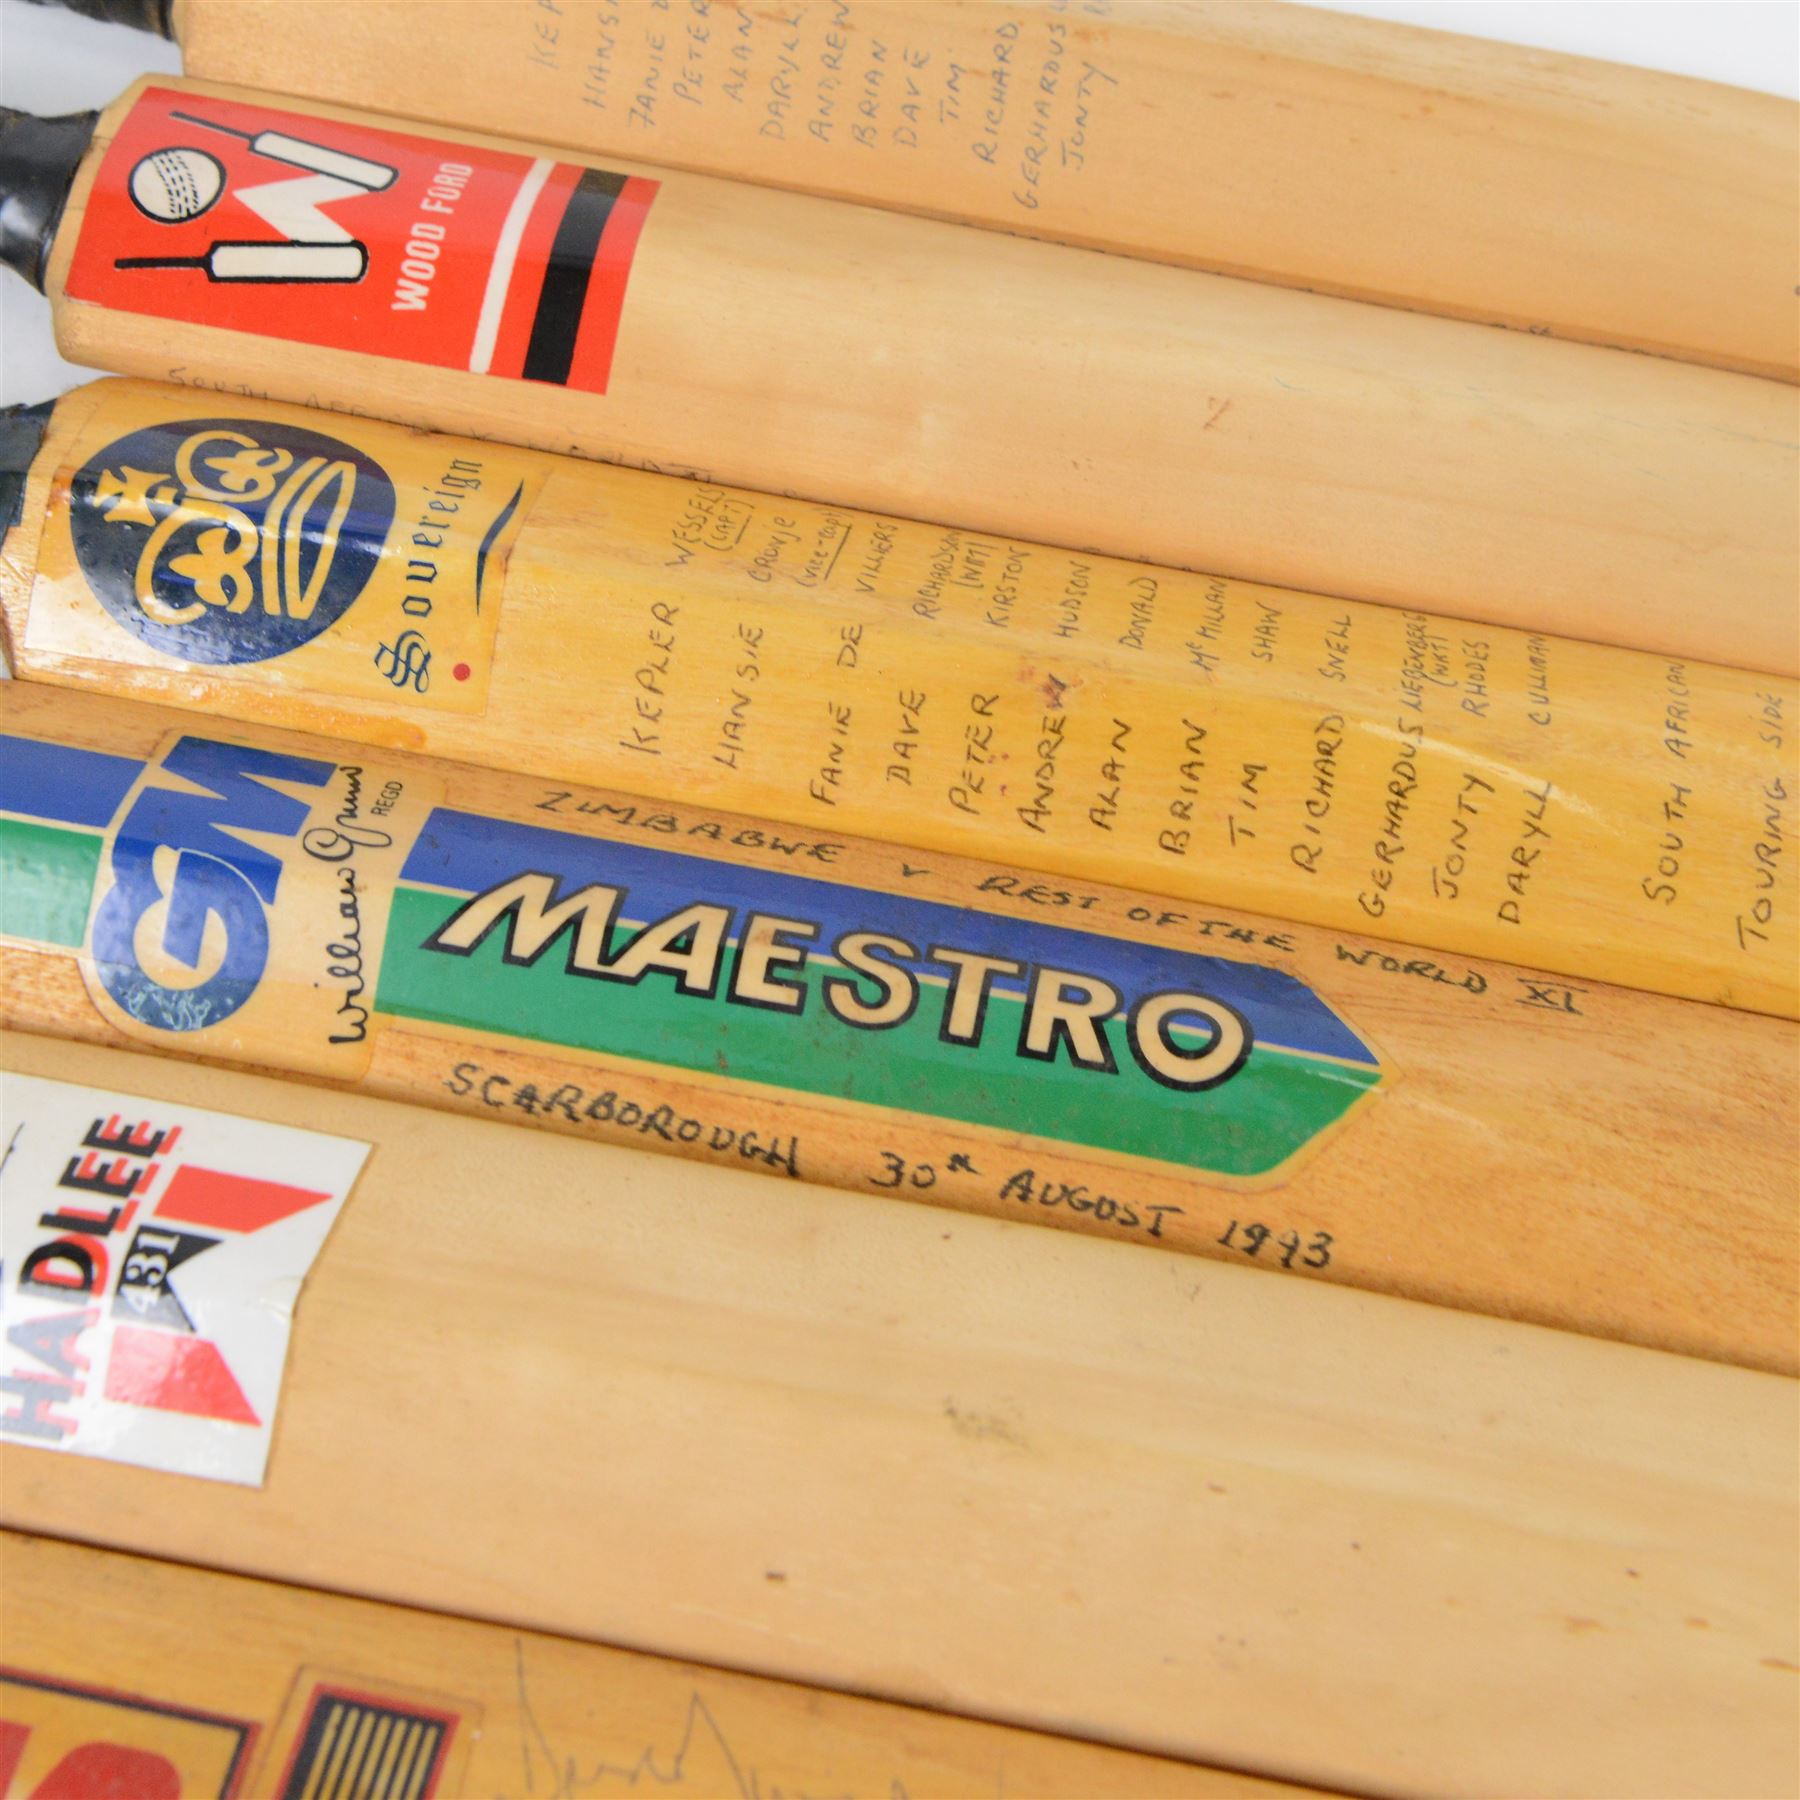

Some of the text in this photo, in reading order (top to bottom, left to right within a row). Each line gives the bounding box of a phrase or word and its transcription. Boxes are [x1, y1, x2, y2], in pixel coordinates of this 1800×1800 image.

[722, 8, 754, 103] ALAN
[852, 38, 888, 149] BRIAN
[893, 47, 931, 149] DAVE
[938, 62, 968, 124] TIM
[971, 22, 1020, 165] RICHARD
[1012, 23, 1067, 210] GERHARDUS
[1060, 60, 1120, 172] JONTY
[390, 162, 474, 312] WOOD FORD
[374, 457, 484, 695] Sovereign
[619, 601, 680, 756] KEPLER
[712, 622, 764, 770] HANSIE
[809, 701, 851, 806] FANIE
[836, 623, 863, 669] DE
[885, 689, 927, 787] DAVE
[949, 692, 1001, 816] PETER
[1017, 559, 1094, 834] ANDREW HUDSON
[1088, 575, 1160, 832] ALAN DONALD
[1227, 600, 1283, 848] TIM SHAW
[1290, 615, 1353, 875] RICHARD SNELL
[370, 780, 404, 818] REGD
[1158, 717, 1208, 856] BRIAN
[1358, 716, 1425, 919] GERHARDUS
[1432, 638, 1497, 901] JONTY RHODES
[1497, 781, 1554, 926] DARYLL
[1641, 659, 1694, 907] SOUTH AFRICAN
[1736, 691, 1789, 952] TOURING SIDE
[91, 735, 339, 1032] GM
[534, 789, 846, 864] ZIMBABWE
[975, 874, 1102, 910] REST
[1126, 906, 1190, 928] OF
[1197, 919, 1298, 953] THE
[1334, 942, 1490, 996] WORLD
[1514, 975, 1591, 1016] XI
[419, 869, 1255, 1094] MAESTRO
[441, 1061, 802, 1178] SCARBOROUGH
[999, 1168, 1187, 1239] AUGUST
[0, 1114, 183, 1442] HADLEE
[117, 1229, 183, 1317] 431
